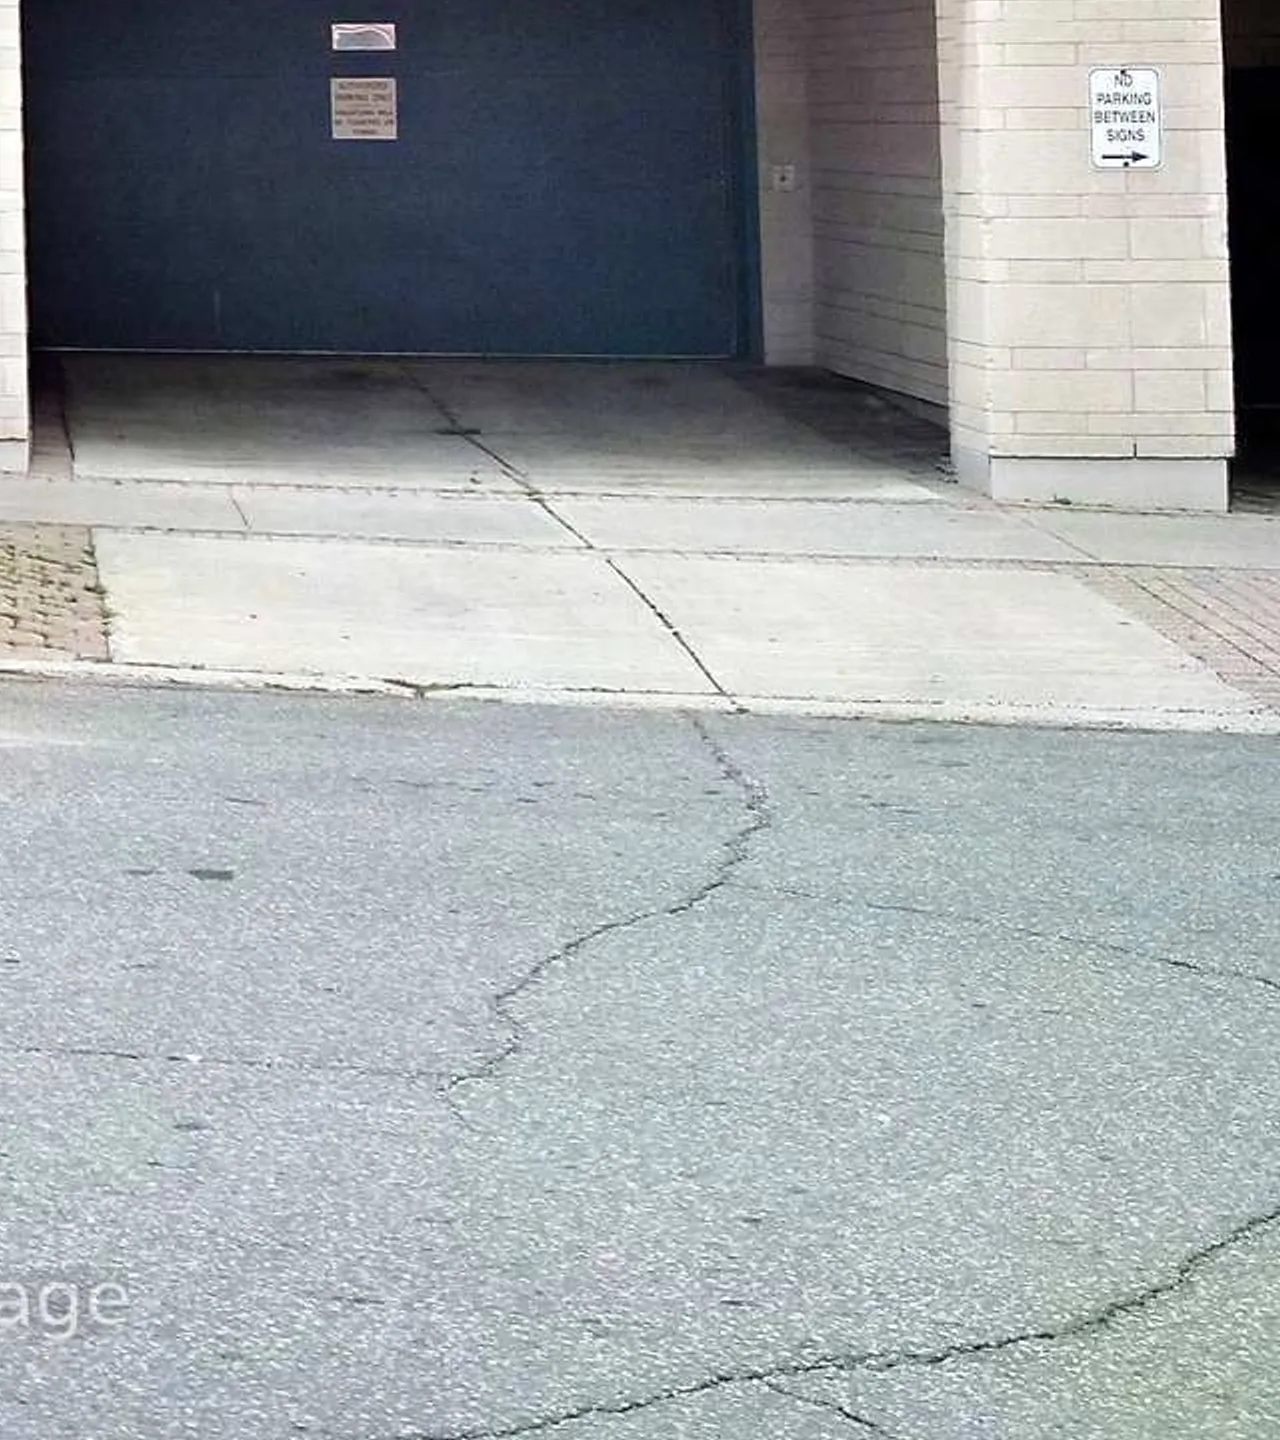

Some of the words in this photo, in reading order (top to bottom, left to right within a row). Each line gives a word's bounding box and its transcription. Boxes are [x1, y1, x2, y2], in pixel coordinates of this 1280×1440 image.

[1114, 73, 1133, 88] NO
[1096, 92, 1152, 105] PARKING
[1094, 110, 1155, 123] BETWEEN
[1106, 128, 1145, 141] SIGNS
